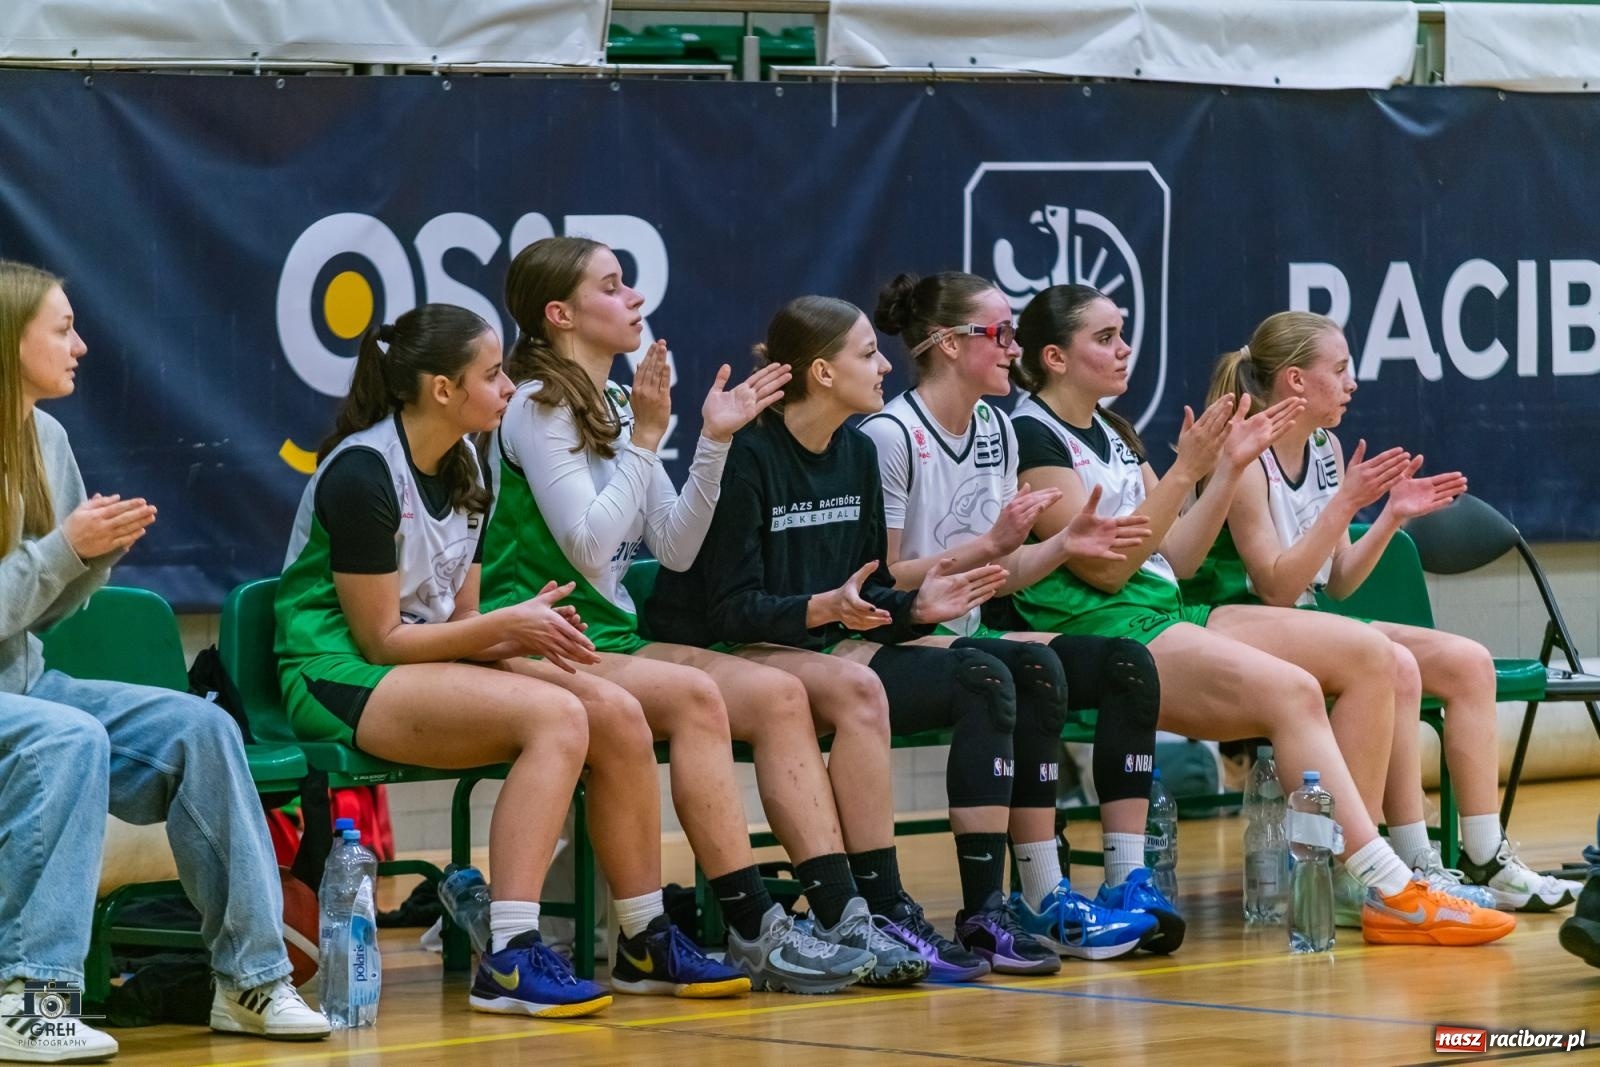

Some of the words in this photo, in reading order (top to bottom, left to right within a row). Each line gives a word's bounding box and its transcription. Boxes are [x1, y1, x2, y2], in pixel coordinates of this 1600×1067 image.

[276, 211, 678, 398] OSR
[790, 501, 813, 512] AZS
[819, 494, 861, 509] RACIBÓRZ
[1135, 754, 1153, 773] NBA
[353, 943, 368, 982] polaris
